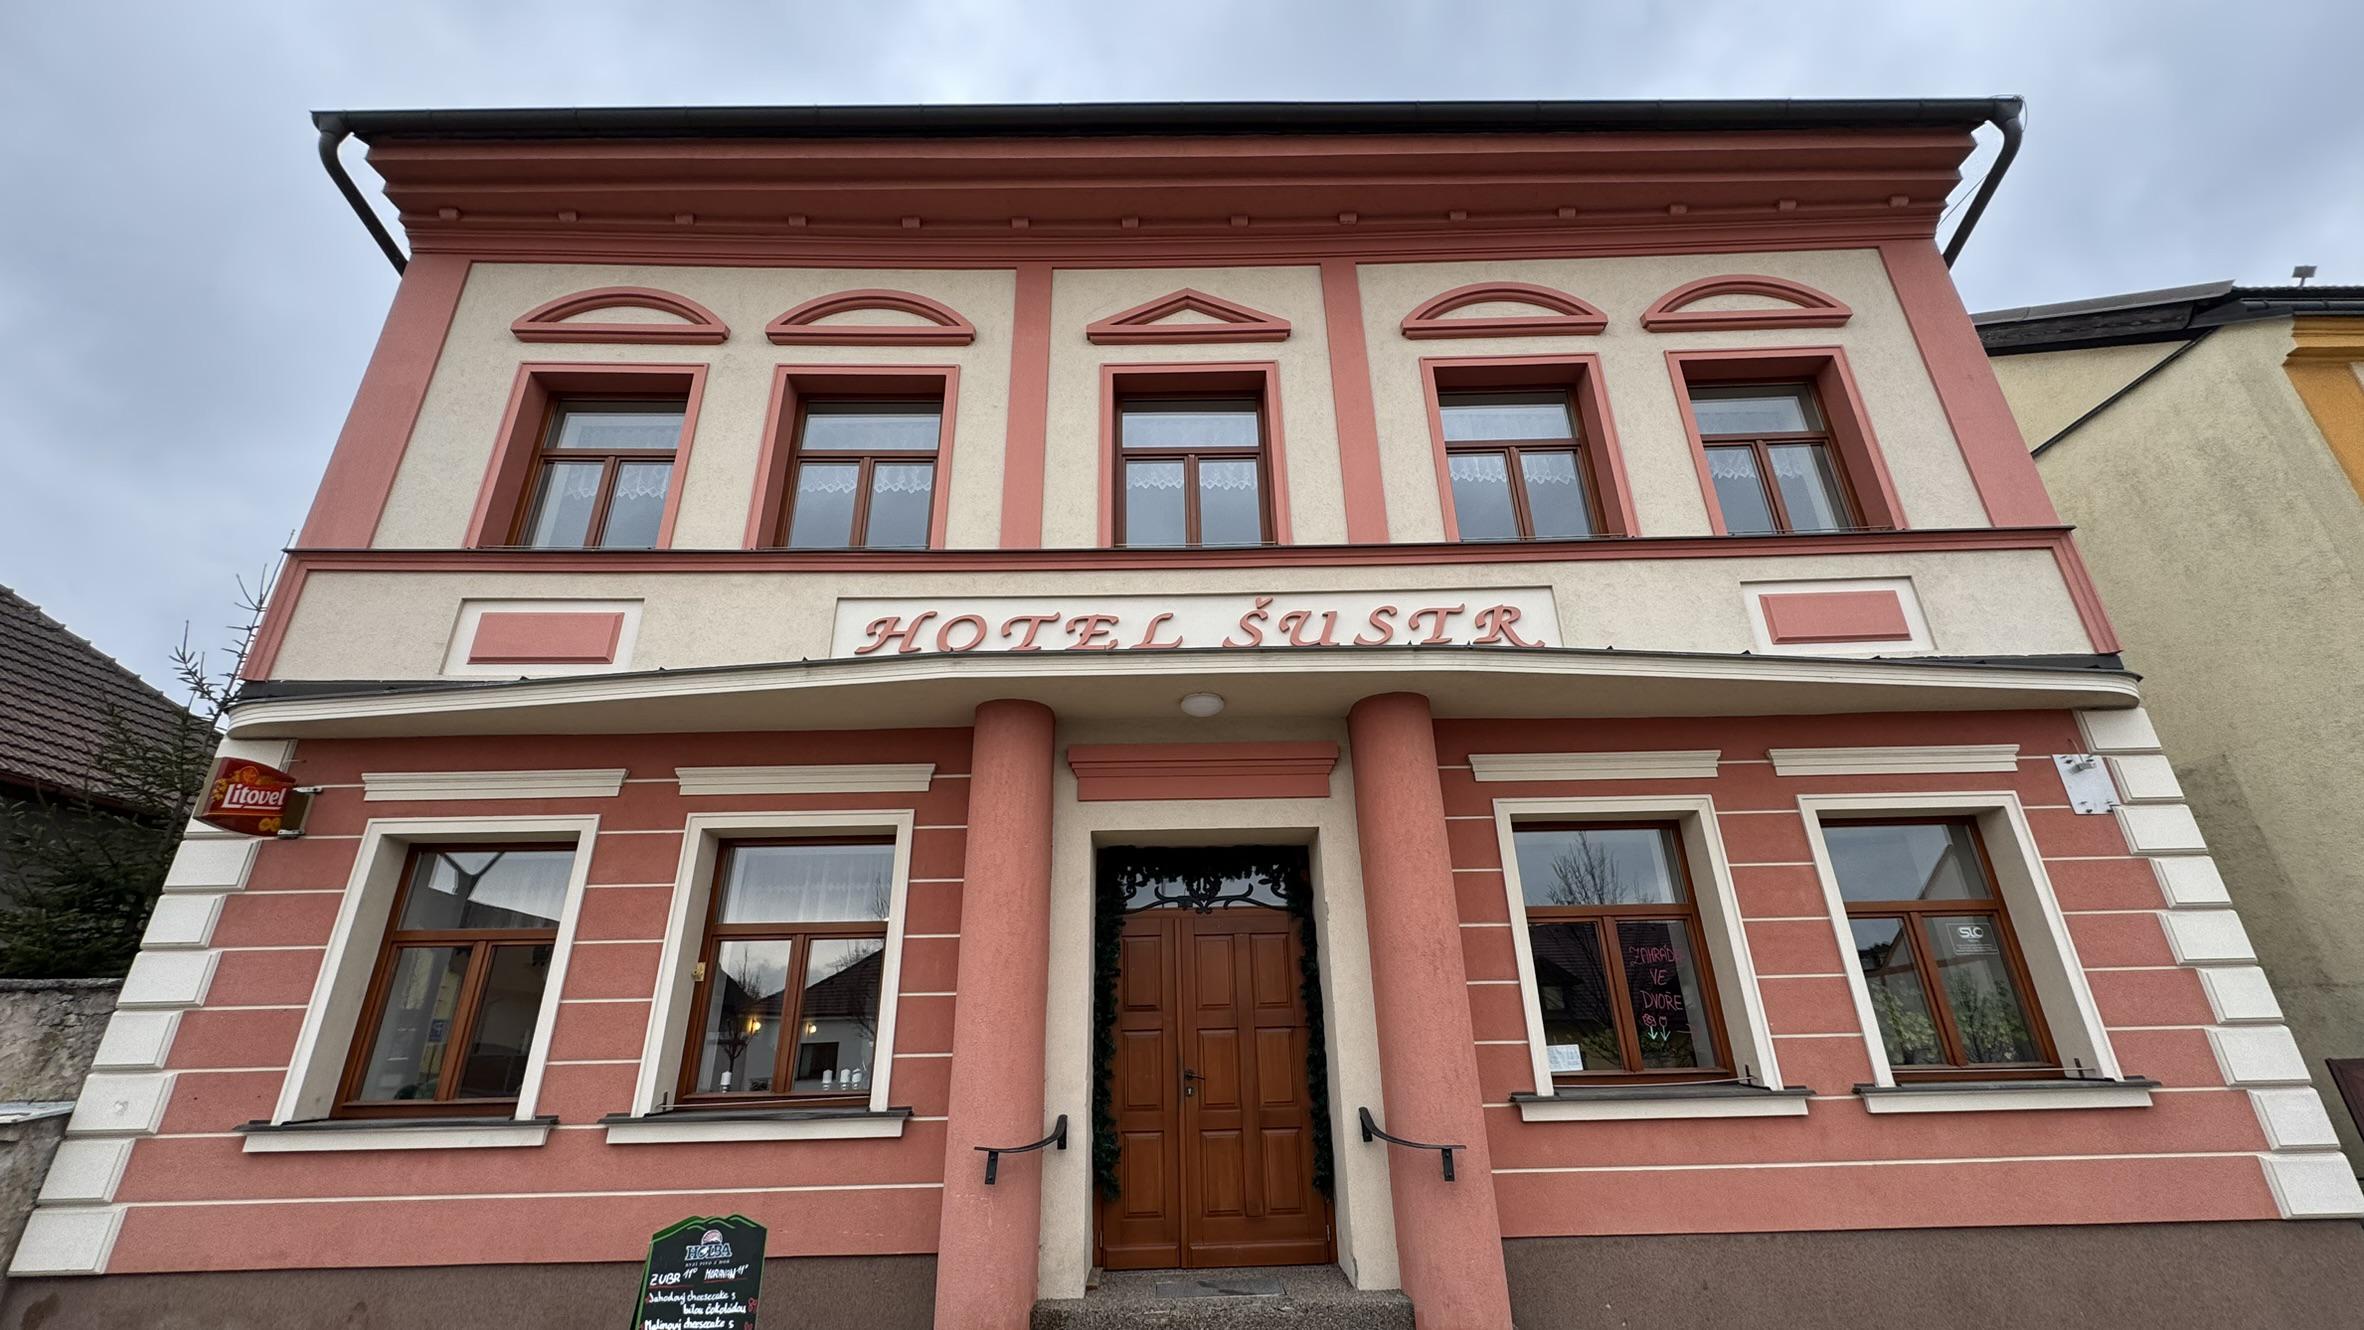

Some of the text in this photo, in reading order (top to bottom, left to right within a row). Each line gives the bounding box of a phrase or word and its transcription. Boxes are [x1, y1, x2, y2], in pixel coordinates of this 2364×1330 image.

[853, 596, 1546, 655] HOTEL ŠUSTR
[220, 783, 288, 809] Litovel
[1628, 944, 1686, 967] ZAHRÁD
[1648, 968, 1668, 986] VE
[1640, 990, 1683, 1011] DVOŘE
[685, 1243, 733, 1261] HOLBA
[650, 1273, 681, 1286] ZUBR
